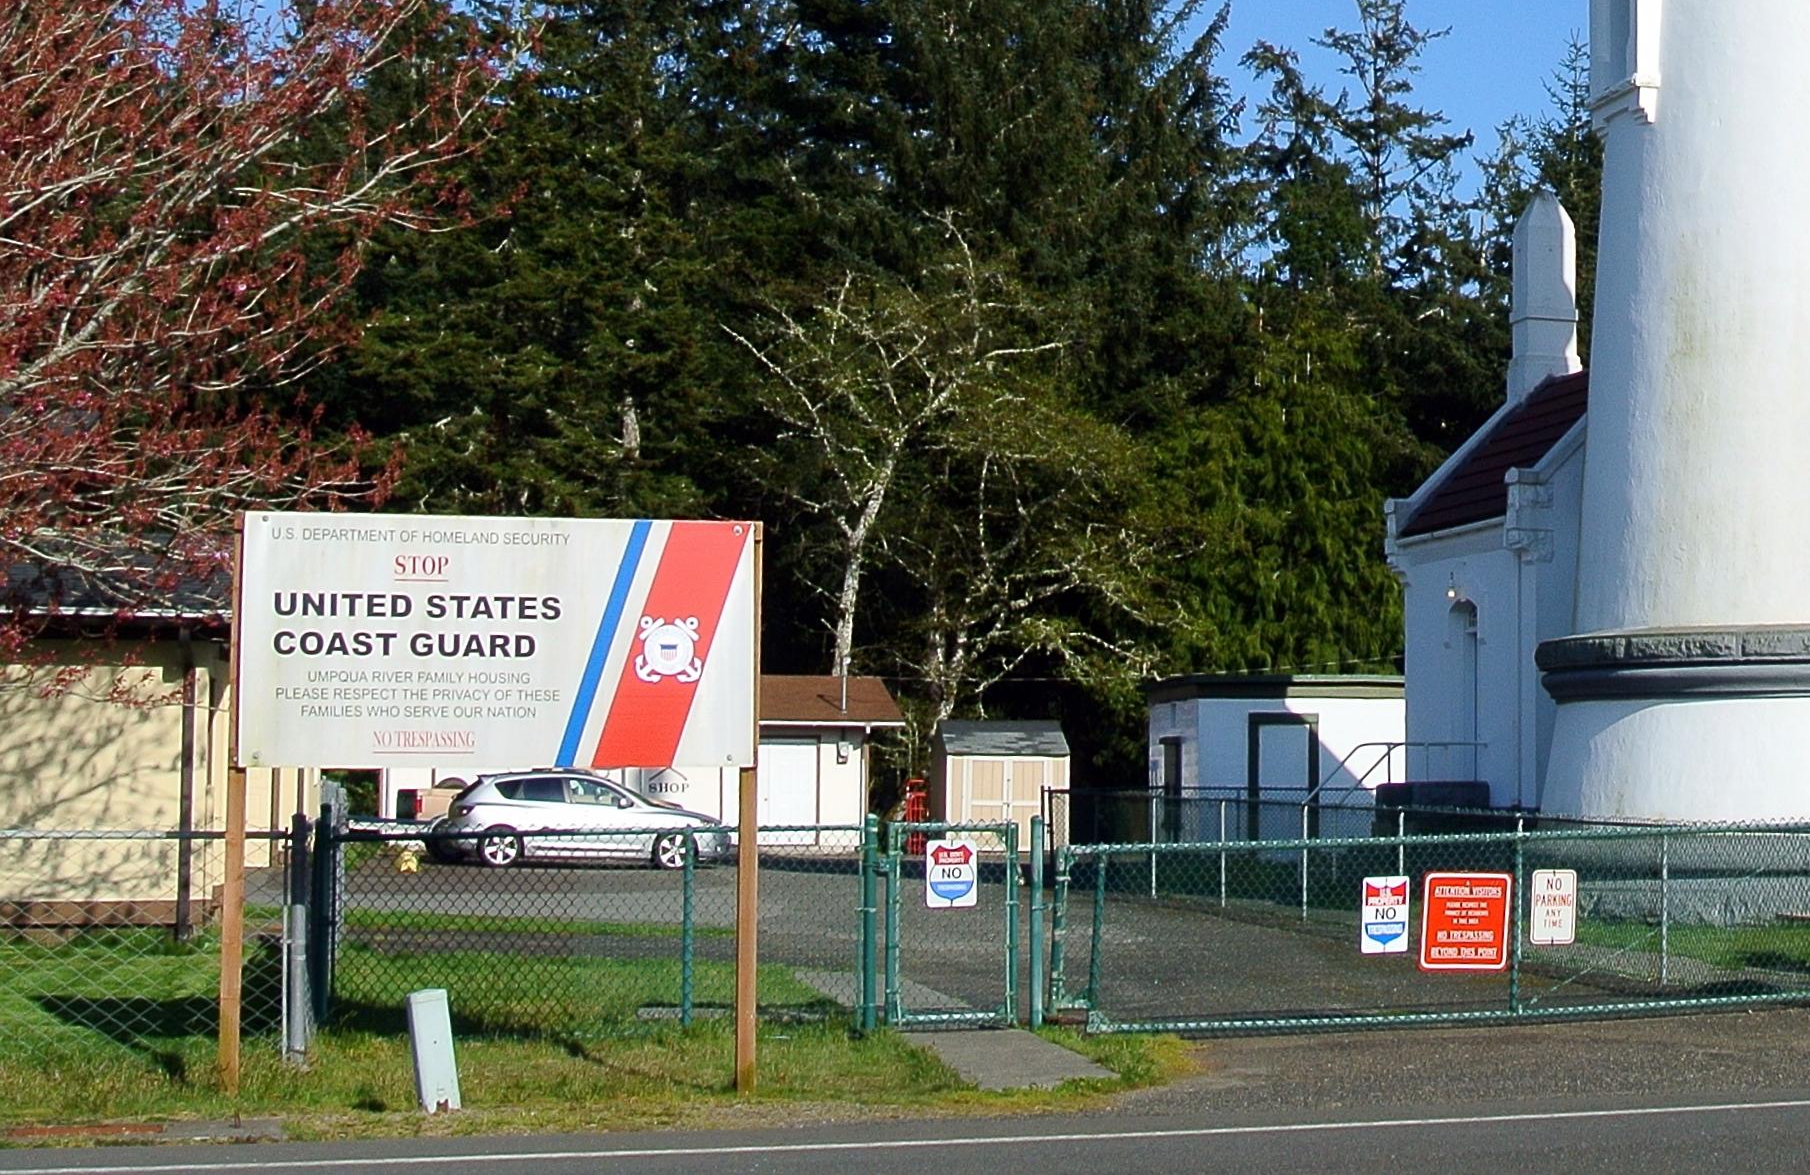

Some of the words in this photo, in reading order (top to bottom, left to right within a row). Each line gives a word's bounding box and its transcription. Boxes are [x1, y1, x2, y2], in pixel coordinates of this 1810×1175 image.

[272, 527, 297, 540] U.S.
[303, 528, 396, 542] DEPARTMENT
[400, 530, 418, 542] OF
[423, 531, 499, 544] HOMELAND
[503, 533, 570, 545] SECURITY
[395, 556, 448, 574] STOP
[275, 593, 412, 617] UNITED
[426, 595, 561, 620] STATES
[274, 631, 397, 656] COAST
[410, 633, 535, 657] GUARD
[308, 671, 368, 682] UMPQUA
[372, 671, 413, 683] RIVER
[418, 671, 464, 683] FAMILY
[468, 672, 530, 684] HOUSING
[276, 687, 328, 700] PLEASE
[334, 688, 397, 700] RESPECT
[402, 689, 428, 700] THE
[433, 689, 490, 701] PRIVACY
[494, 689, 512, 701] OF
[517, 690, 560, 701] THESE
[301, 705, 362, 717] FAMILIES
[367, 706, 400, 717] WHO
[404, 706, 448, 718] SERVE
[453, 706, 483, 718] OUR
[487, 707, 536, 718] NATION
[373, 730, 392, 746] NO
[395, 730, 475, 747] TRESPASSING
[648, 782, 690, 793] SHOP
[942, 867, 962, 879] NO
[1435, 886, 1470, 895] ATTENTION
[1472, 887, 1502, 896] VISITORS
[1546, 878, 1562, 891] NO
[1535, 894, 1572, 906] PARKING
[1375, 907, 1396, 920] NO
[1545, 909, 1561, 917] ANY
[1544, 919, 1562, 928] TIME
